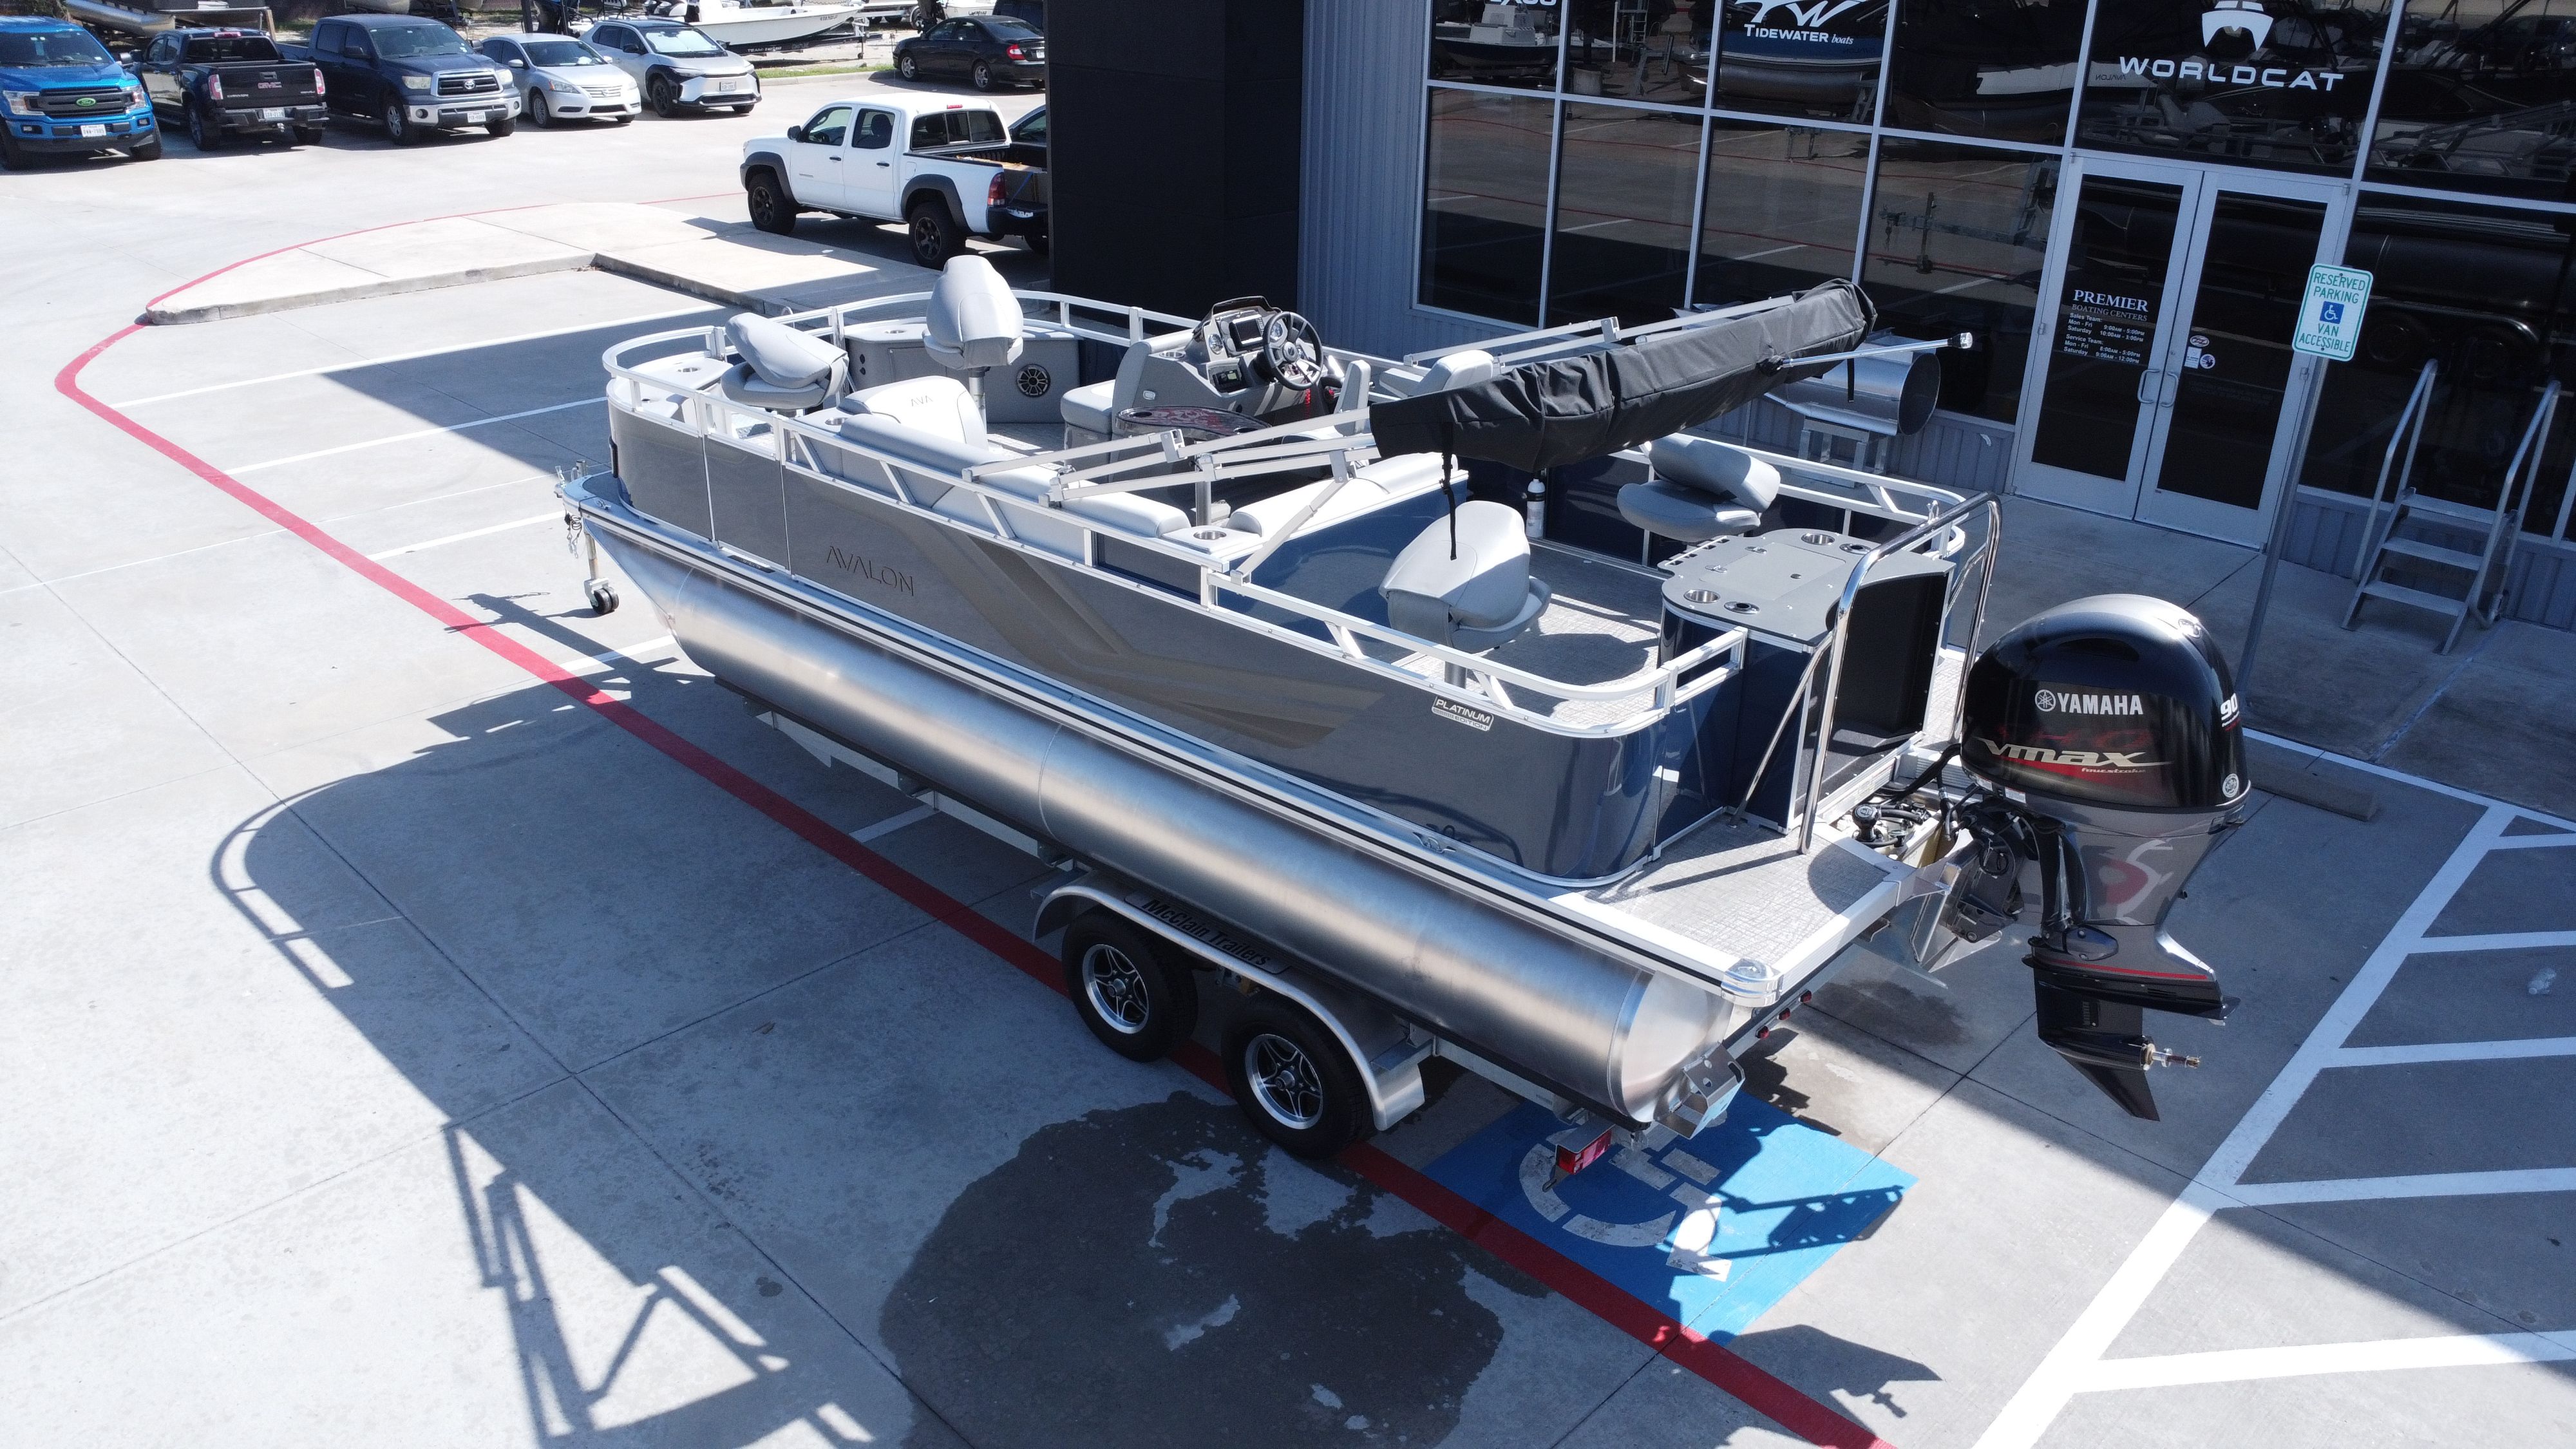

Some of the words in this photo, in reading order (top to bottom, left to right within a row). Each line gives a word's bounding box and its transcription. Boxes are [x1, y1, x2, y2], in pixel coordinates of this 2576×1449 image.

[1744, 24, 1828, 43] TIDEWATER
[1831, 34, 1854, 44] boats
[2119, 57, 2344, 91] WORLDCAT
[2313, 272, 2365, 291] RESERVED
[2073, 289, 2148, 312] PREMIER
[2313, 286, 2359, 303] PARKING
[2071, 304, 2109, 316] BOATING
[2110, 310, 2148, 321] CENTERS
[2066, 334, 2087, 342] Service
[2067, 325, 2092, 335] Saturday
[2318, 323, 2339, 337] VAN
[2063, 346, 2088, 356] Saturday
[2298, 333, 2351, 352] ACCESSIBLE
[826, 545, 914, 596] AVALON
[1435, 699, 1491, 724] PLATINUM
[2057, 692, 2144, 715] YAMAHA
[2220, 692, 2238, 721] 90
[1454, 715, 1487, 730] EDITION
[1142, 899, 1211, 937] McClain
[1208, 931, 1271, 966] Trailers
